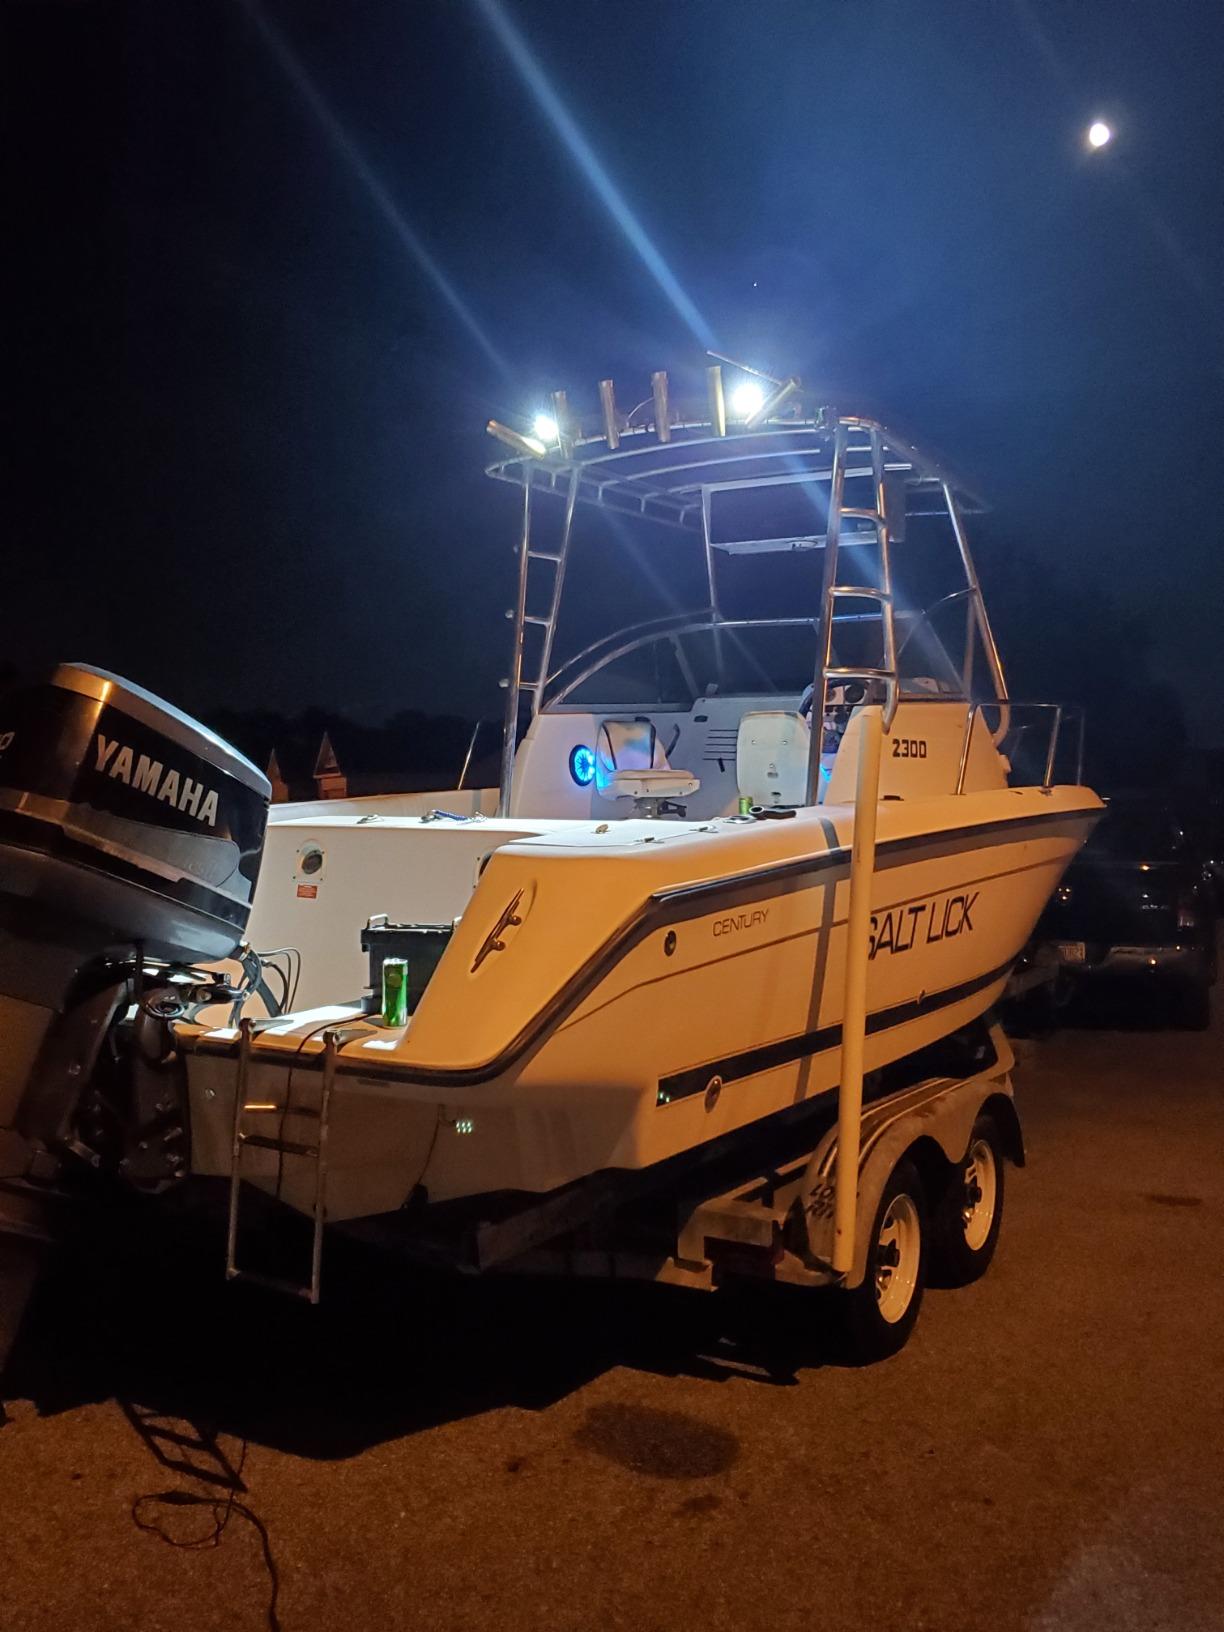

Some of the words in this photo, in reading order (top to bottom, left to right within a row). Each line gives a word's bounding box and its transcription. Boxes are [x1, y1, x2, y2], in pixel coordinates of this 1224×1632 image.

[892, 738, 927, 759] 2300
[93, 733, 220, 827] YAMAHA
[712, 907, 769, 937] CENTURY
[926, 891, 980, 944] LICK
